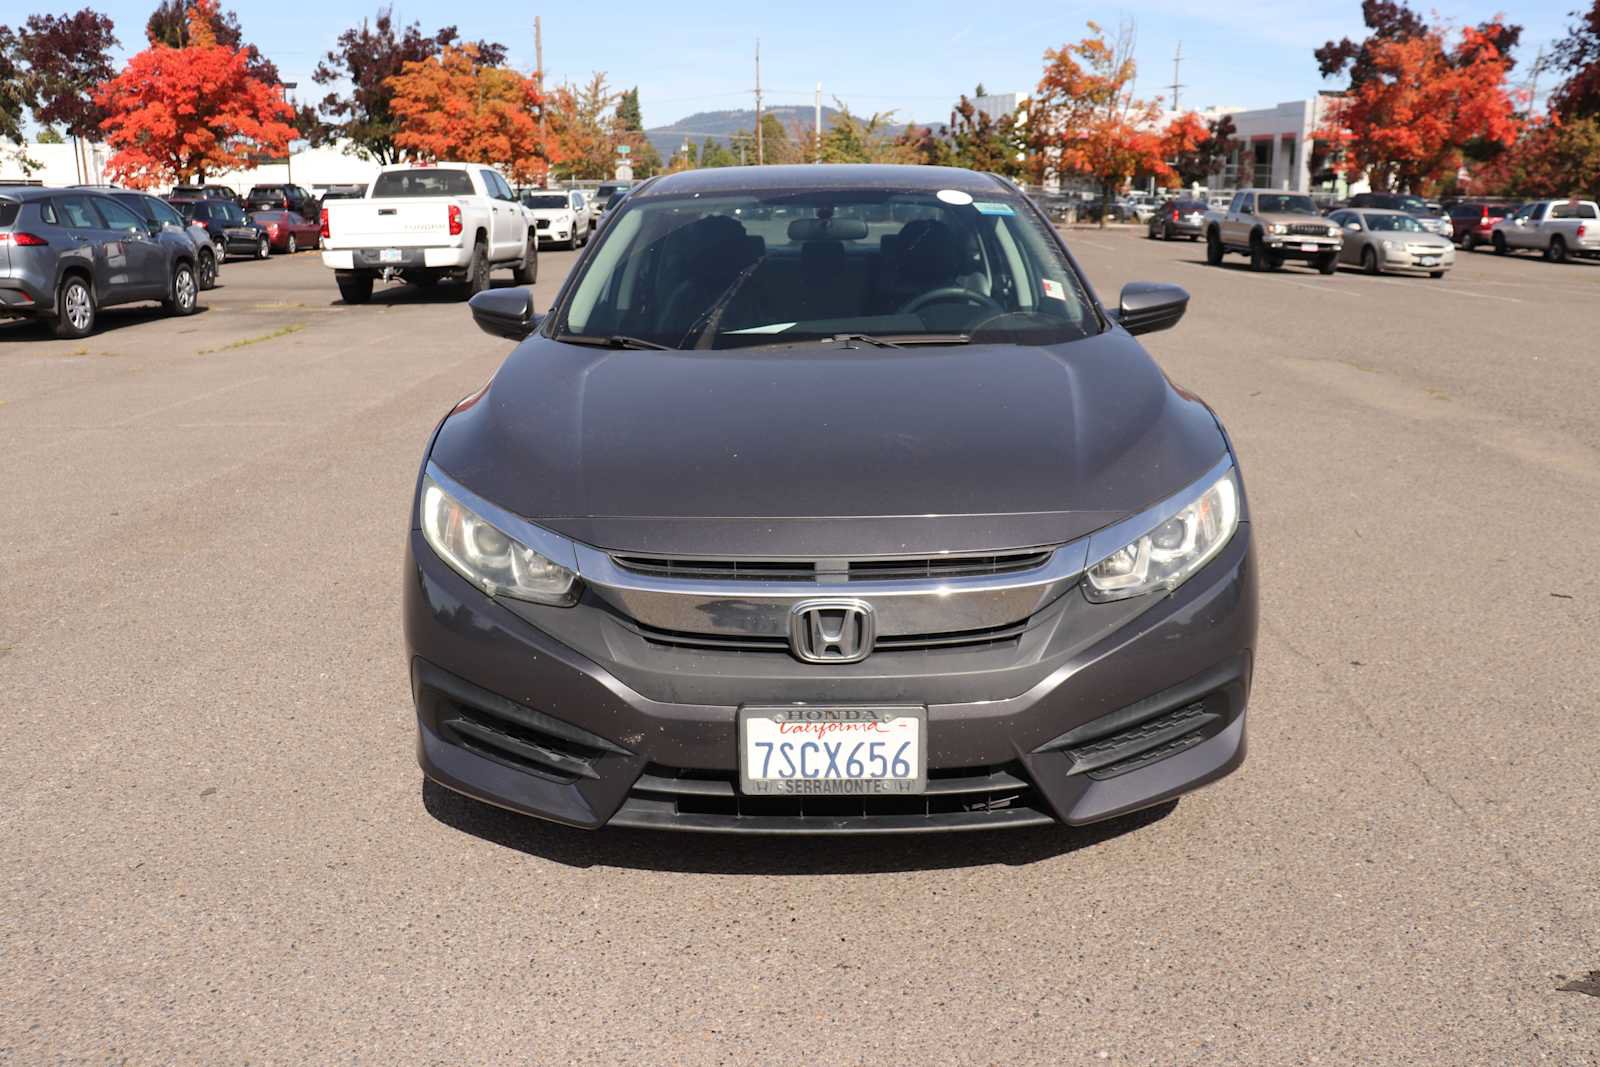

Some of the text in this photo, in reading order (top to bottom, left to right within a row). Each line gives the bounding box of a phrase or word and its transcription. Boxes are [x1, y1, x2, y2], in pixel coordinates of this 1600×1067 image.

[786, 710, 881, 720] HONDA
[780, 719, 889, 739] California
[755, 741, 912, 778] 7SCX656
[785, 779, 882, 794] SERRAMONTE
